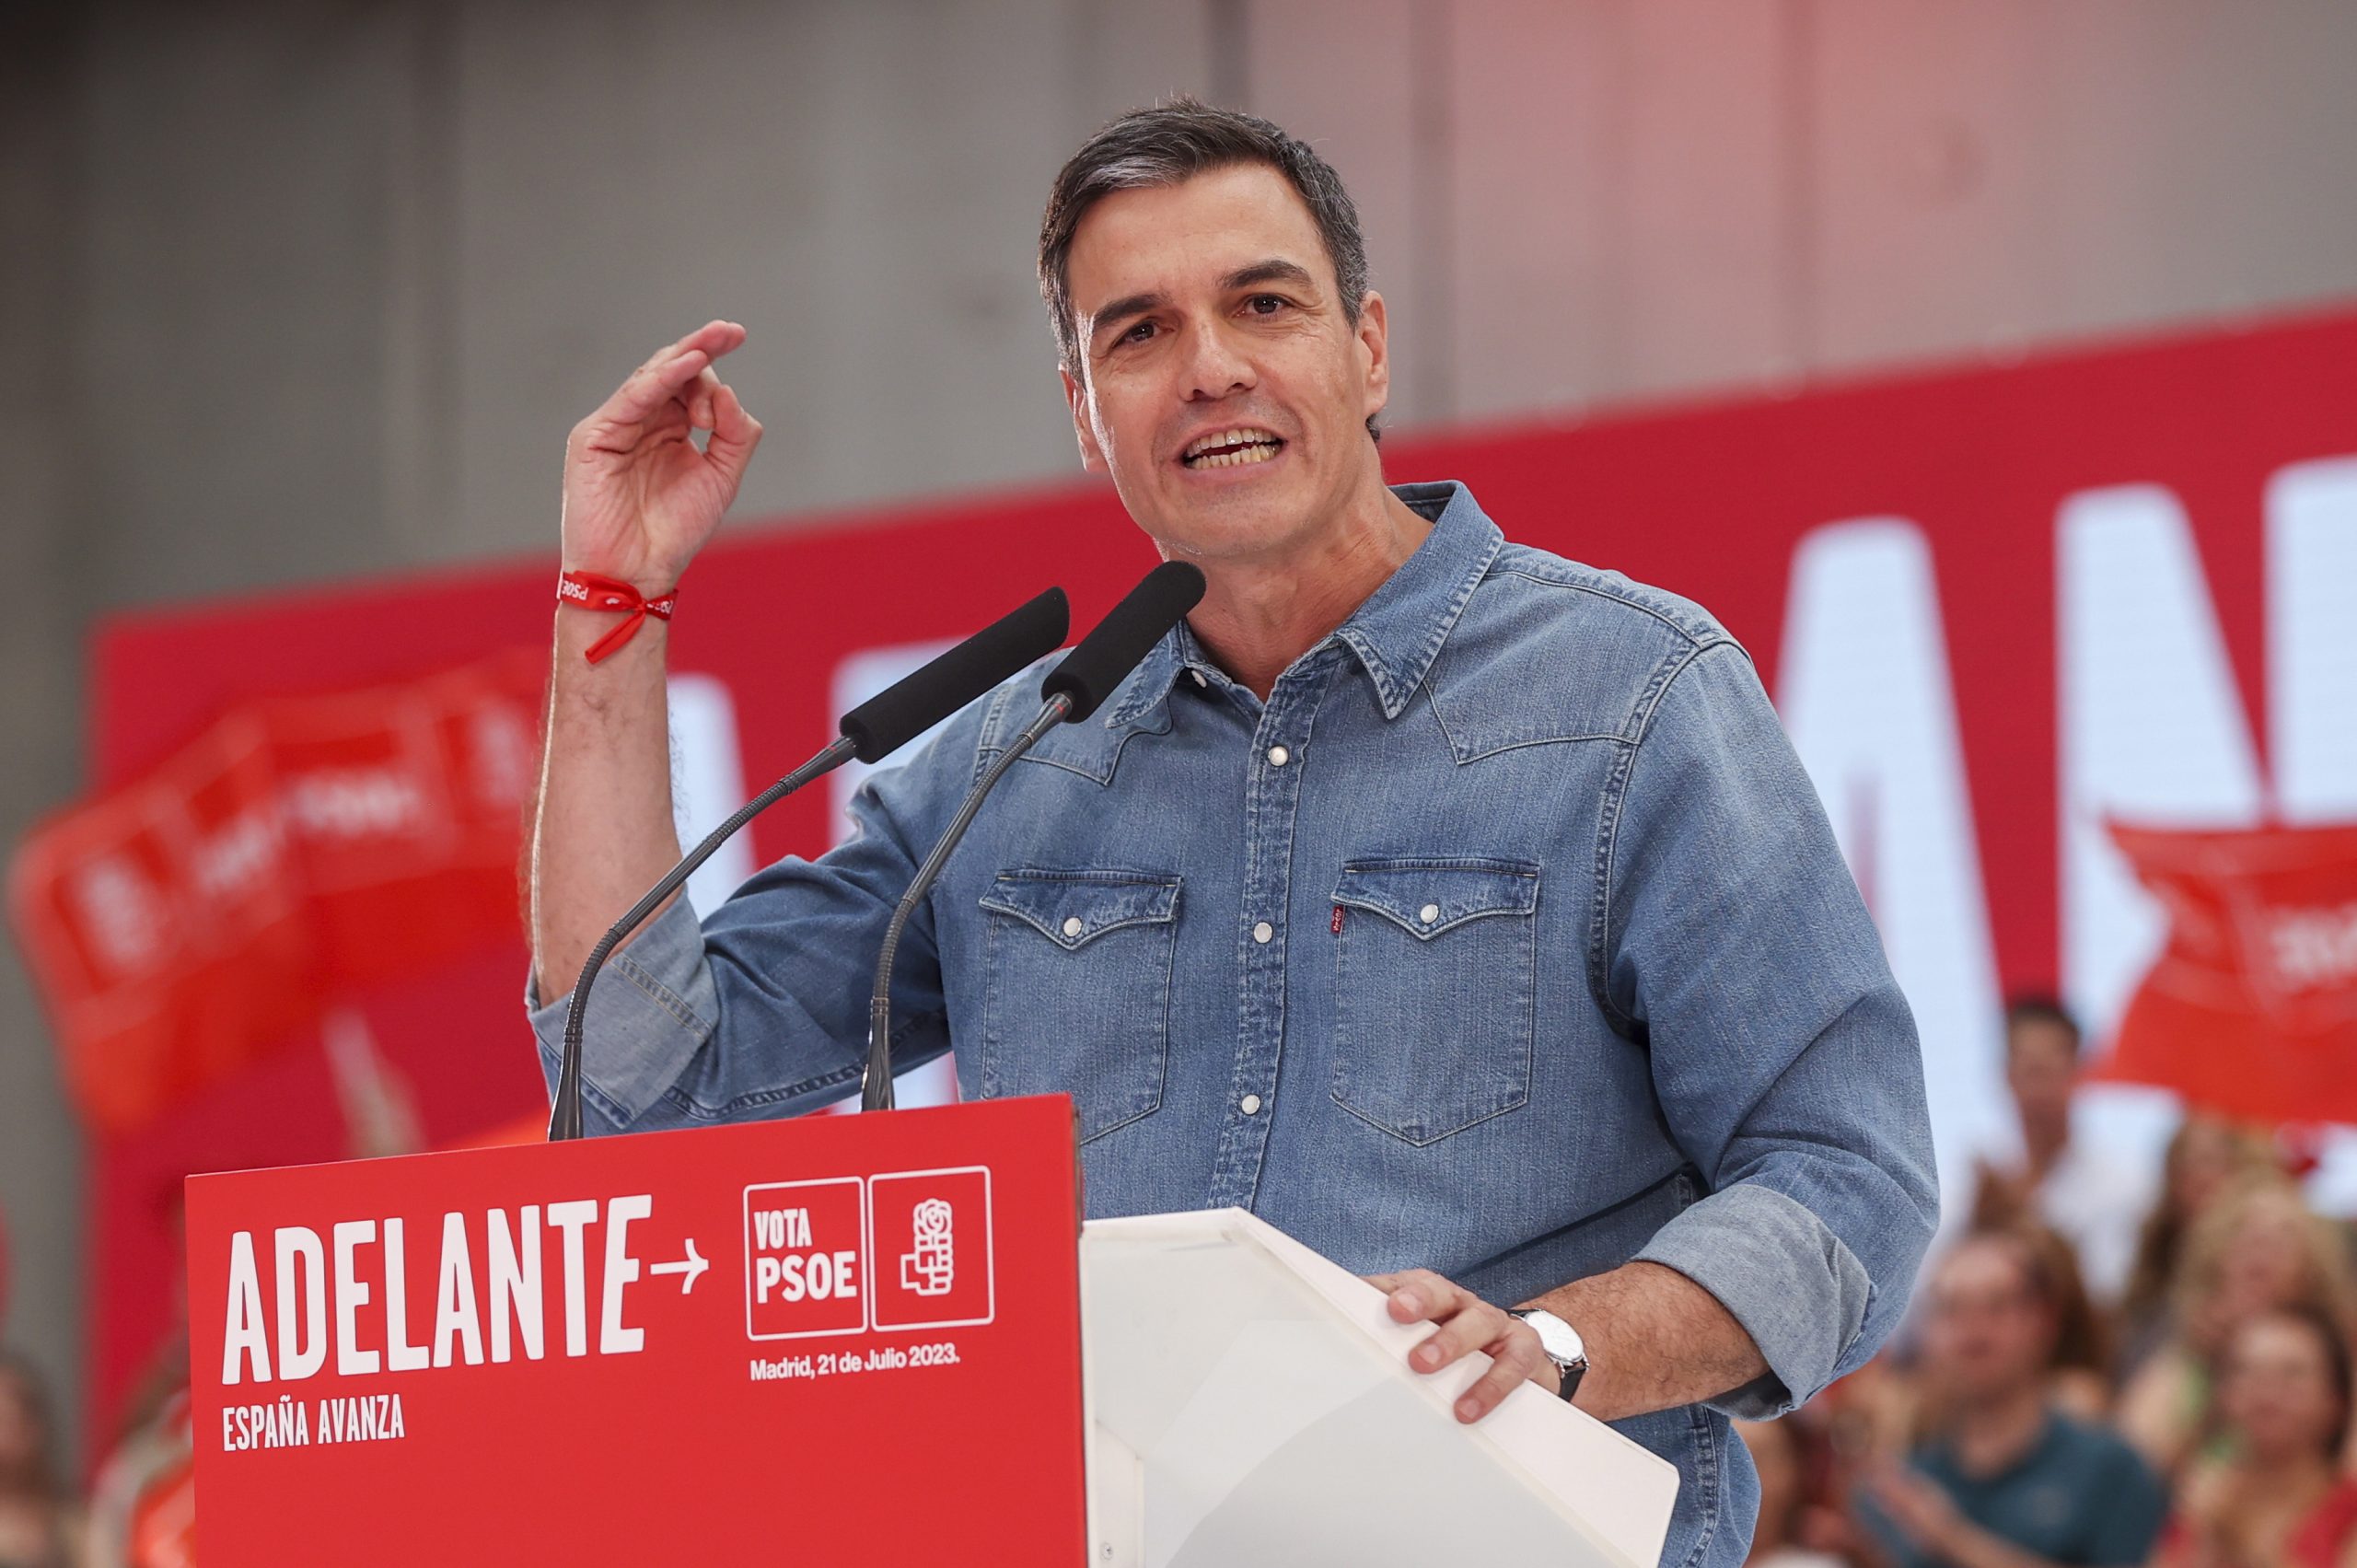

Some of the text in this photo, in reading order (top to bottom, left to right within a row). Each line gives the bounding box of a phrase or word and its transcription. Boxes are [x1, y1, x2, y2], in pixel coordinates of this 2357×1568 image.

[753, 1207, 813, 1250] VOTA
[222, 1194, 653, 1386] ADELANTE
[756, 1250, 858, 1304] PSOE
[749, 1342, 960, 1381] Madrid, 21 de Julio 2023.
[222, 1393, 405, 1452] ESPAÑA AVANZA
